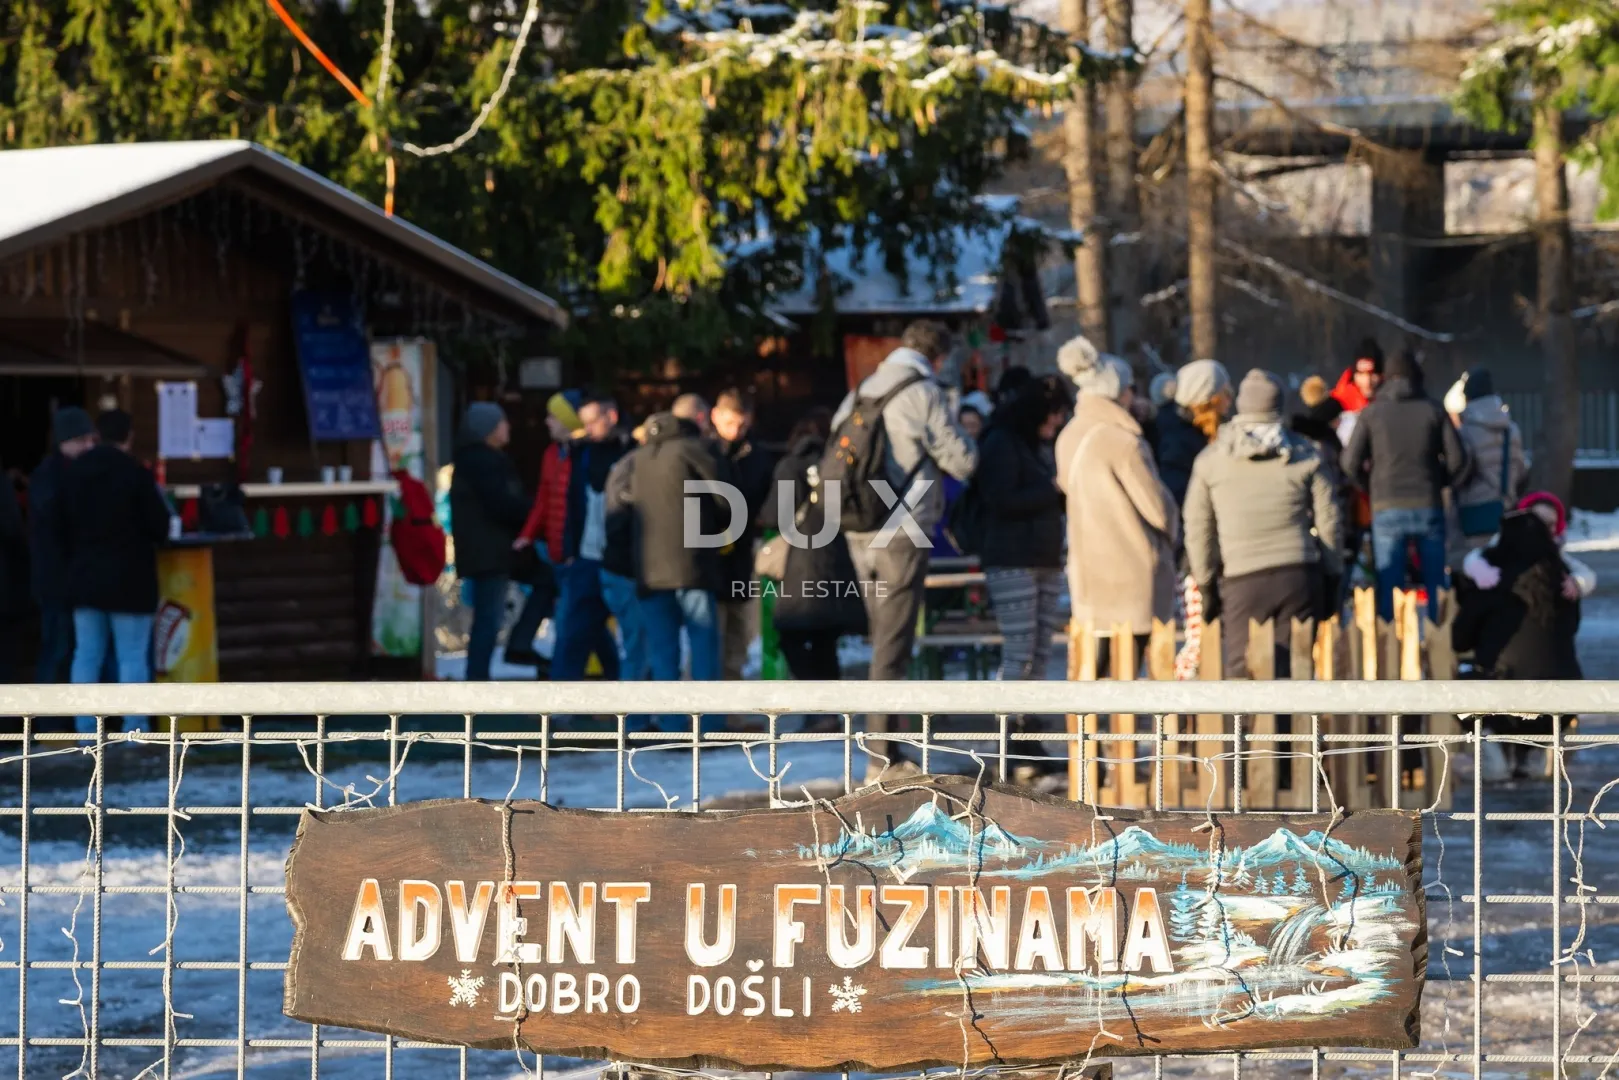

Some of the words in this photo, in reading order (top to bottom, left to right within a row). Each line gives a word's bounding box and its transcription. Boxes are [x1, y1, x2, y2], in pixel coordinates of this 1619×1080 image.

[341, 878, 651, 964] ADVENT
[684, 882, 736, 967] U
[499, 972, 641, 1014] DOBRO
[686, 958, 812, 1017] DOŠLI
